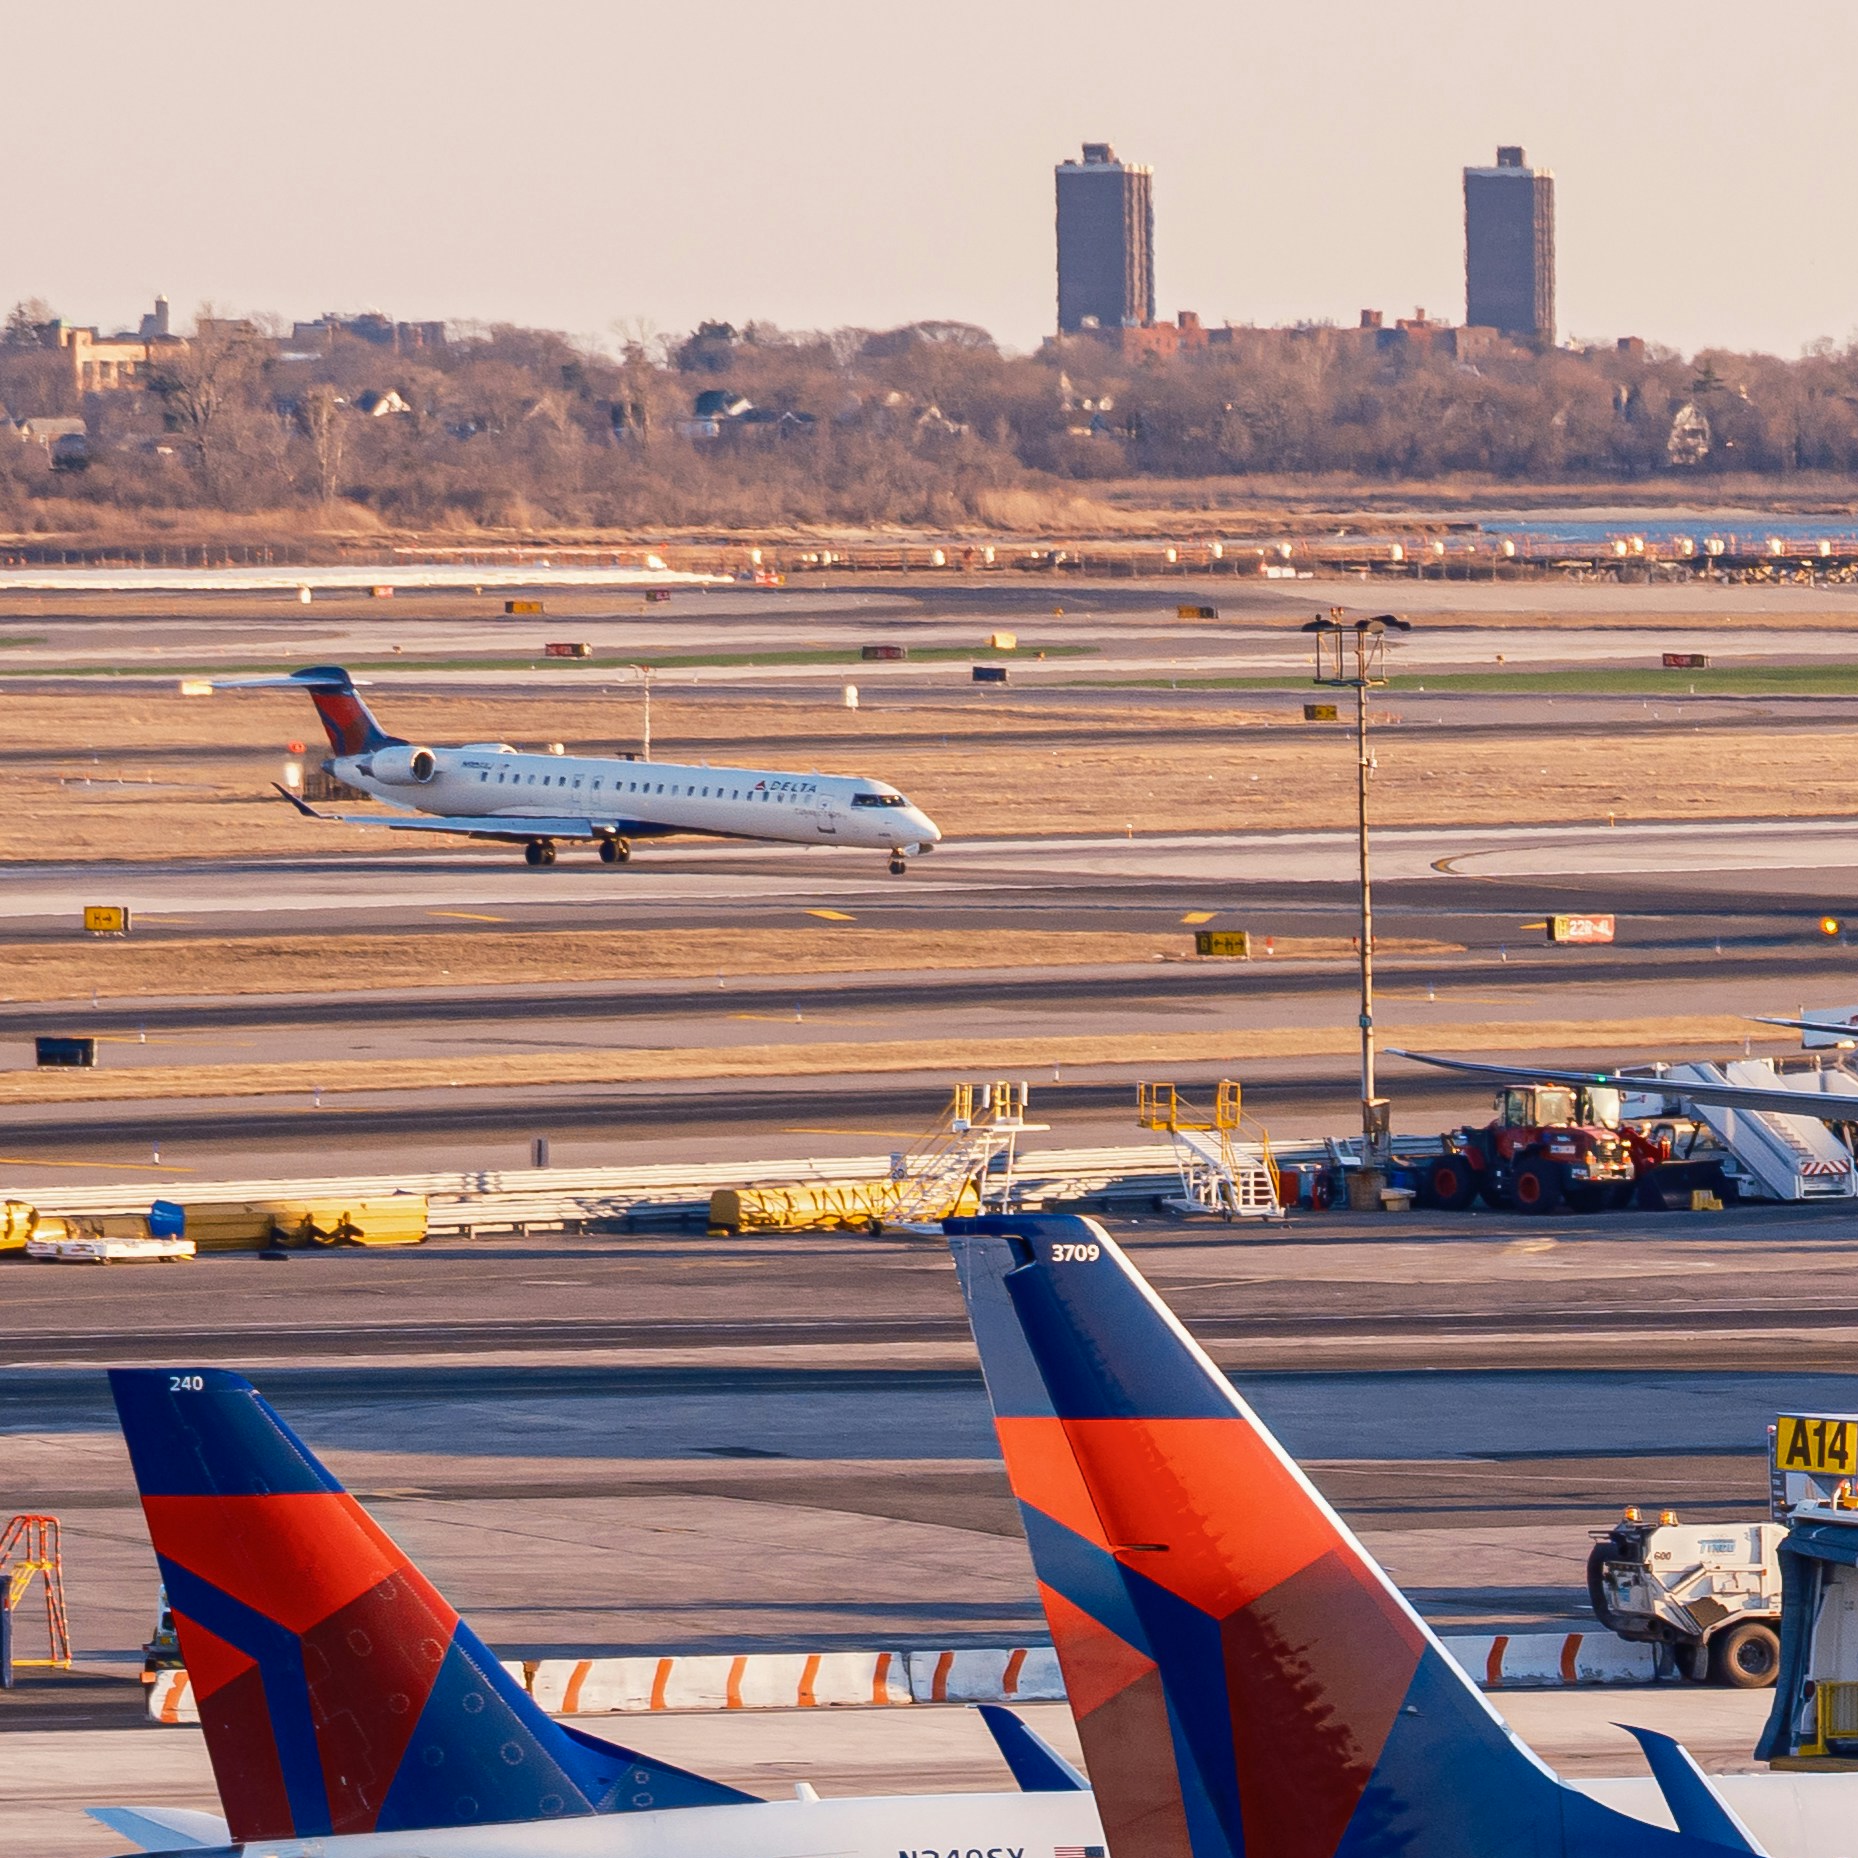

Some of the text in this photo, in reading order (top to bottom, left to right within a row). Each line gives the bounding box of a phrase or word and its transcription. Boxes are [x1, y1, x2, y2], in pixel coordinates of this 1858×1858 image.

[771, 780, 818, 794] DELTA
[1569, 919, 1612, 936] 22R-4L
[1051, 1244, 1100, 1262] 3709
[169, 1376, 204, 1391] 240
[1785, 1418, 1849, 1470] A14
